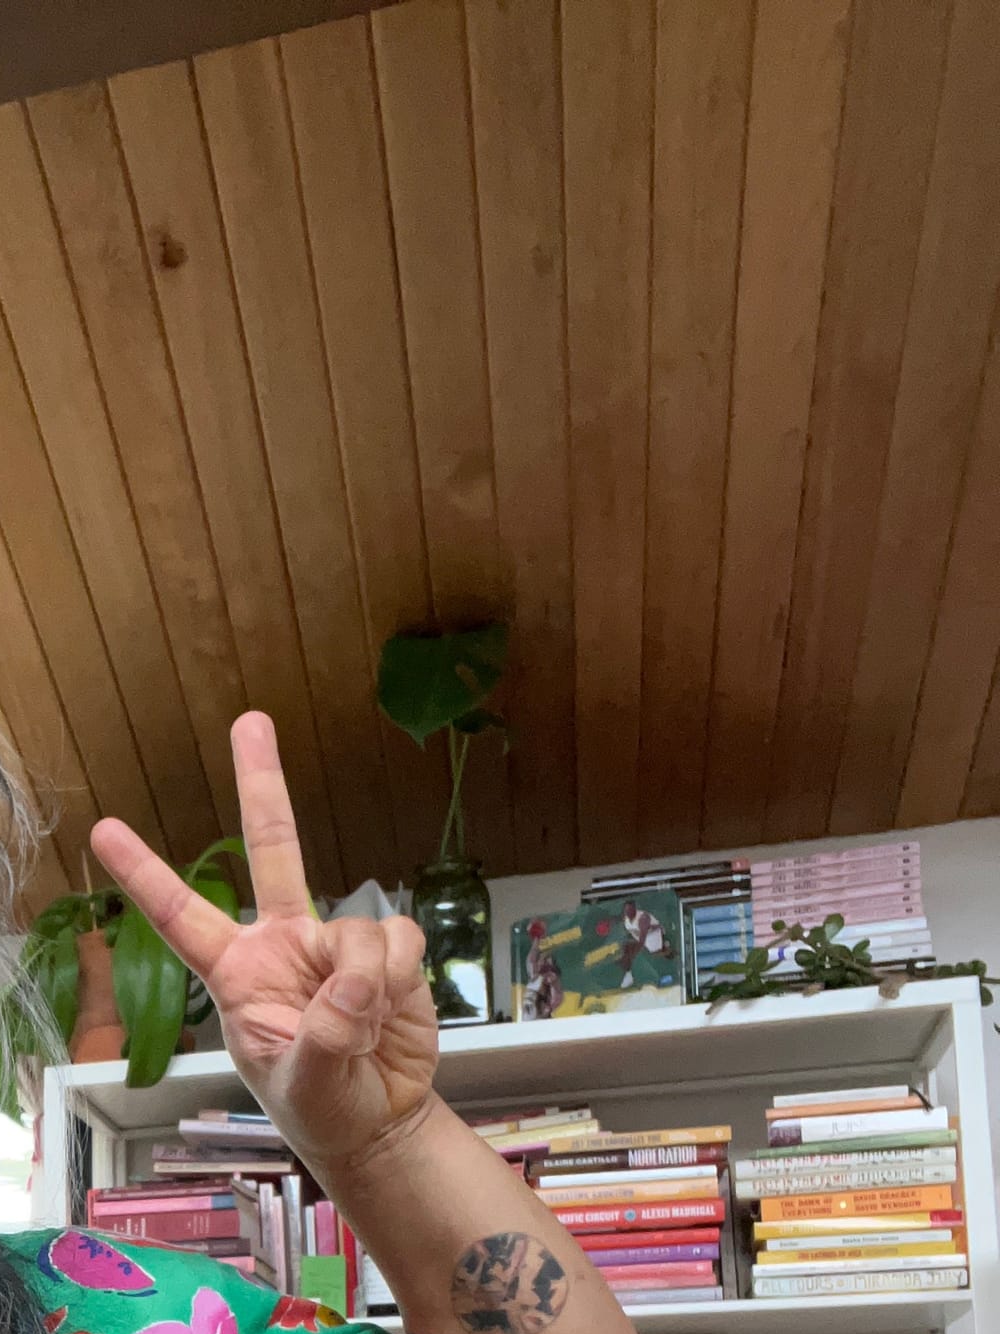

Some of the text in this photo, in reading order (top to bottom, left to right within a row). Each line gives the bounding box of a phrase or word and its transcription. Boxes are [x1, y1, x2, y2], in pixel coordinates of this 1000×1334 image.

[628, 1145, 697, 1168] MODERATION
[557, 1210, 620, 1224] ACIFIC CIRCUIT
[641, 1205, 716, 1220] ALEXIS MADRIGAL
